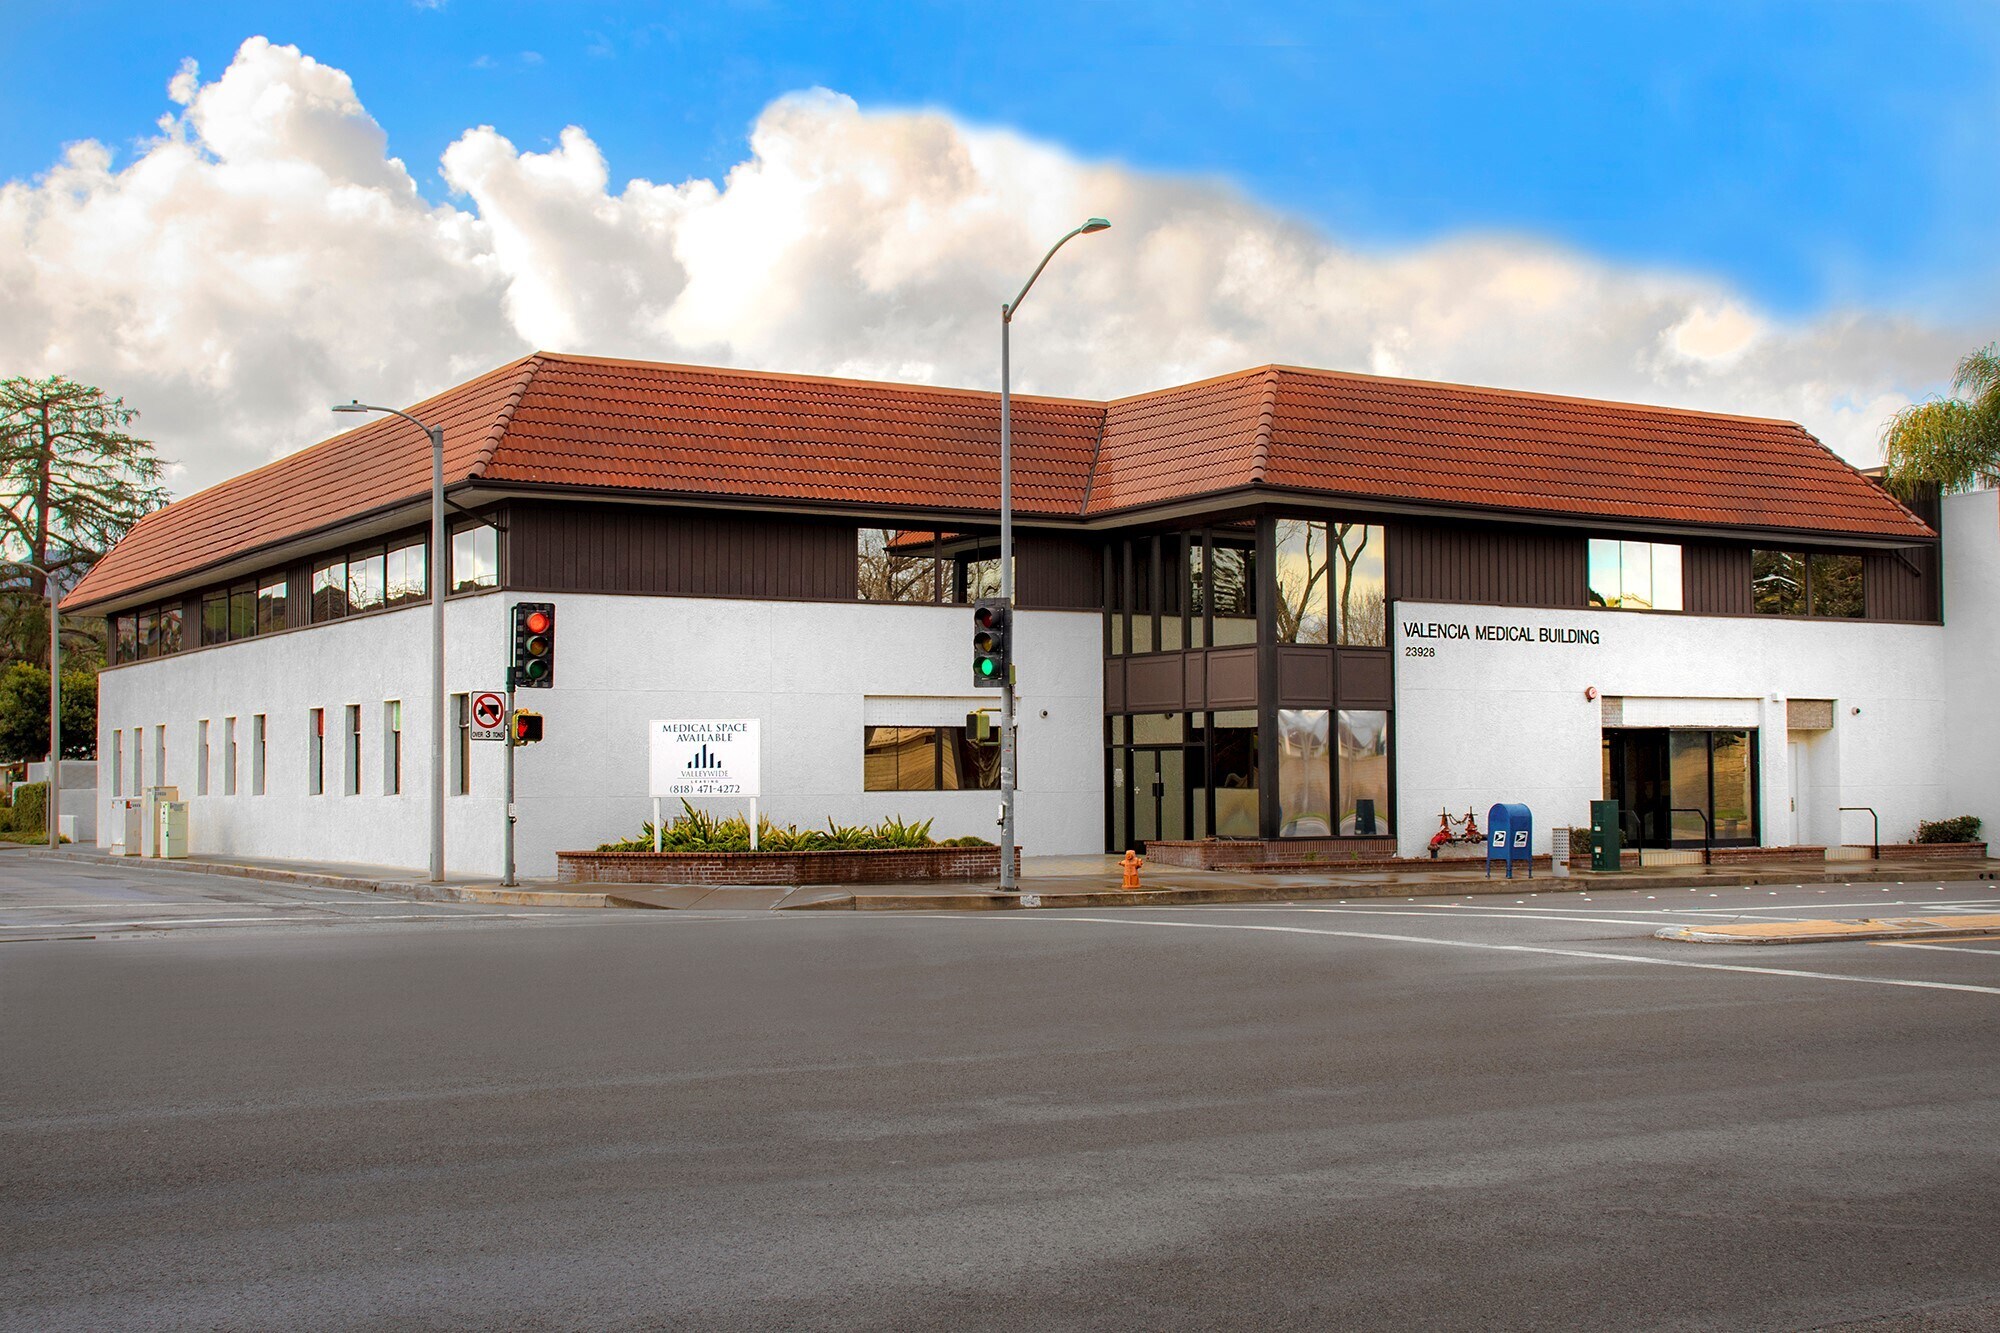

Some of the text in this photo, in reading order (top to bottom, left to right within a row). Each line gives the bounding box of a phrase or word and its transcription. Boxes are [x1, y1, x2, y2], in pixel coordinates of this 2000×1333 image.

[1403, 622, 1600, 644] VALENCIA MEDICAL BUILDING
[1405, 646, 1435, 657] 23928
[662, 723, 747, 733] MEDICAL SPACE
[485, 730, 491, 738] 3
[676, 733, 733, 742] AVAILABLE
[669, 784, 740, 794] (818) 471-4272
